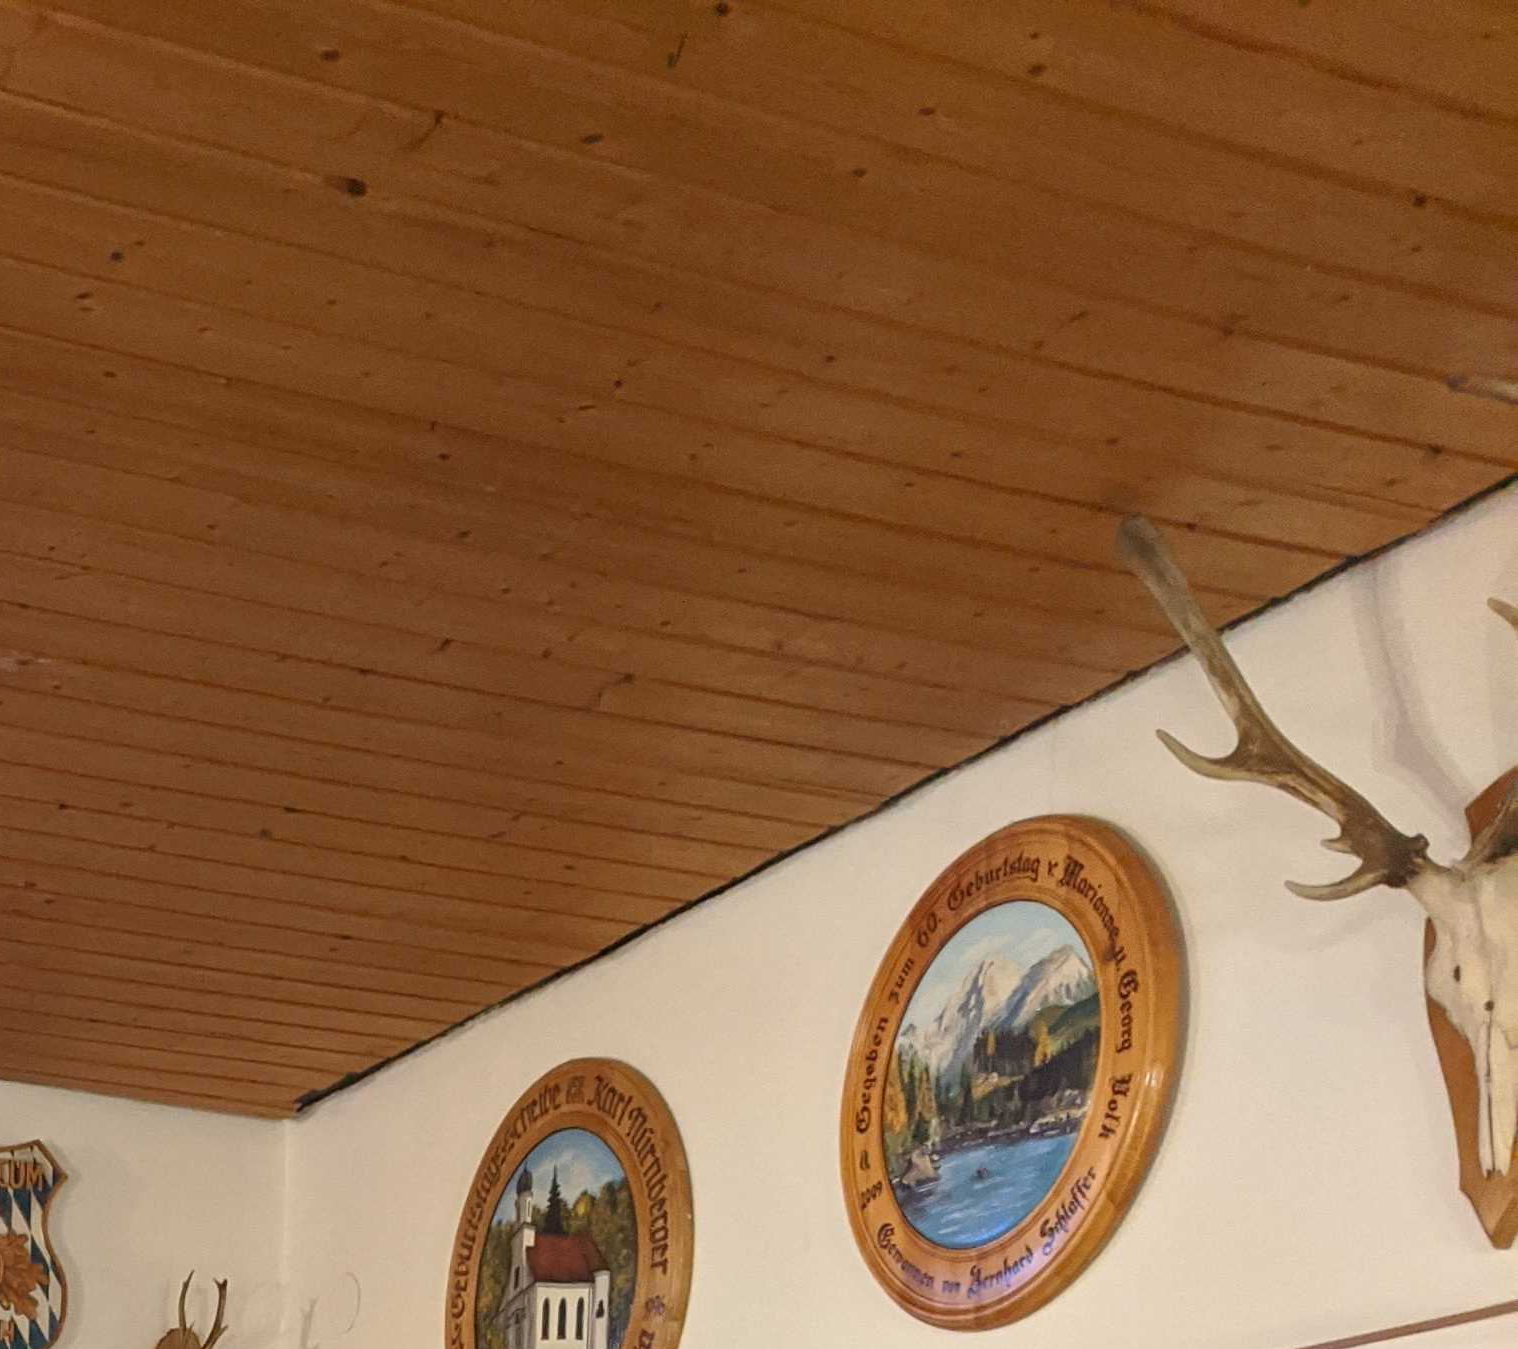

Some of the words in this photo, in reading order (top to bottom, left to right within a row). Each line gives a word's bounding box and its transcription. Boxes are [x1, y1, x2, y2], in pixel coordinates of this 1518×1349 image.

[856, 1017, 888, 1135] Gegeben
[889, 958, 914, 1004] zum
[947, 850, 1040, 911] Geburtstag
[586, 1074, 633, 1126] Karl
